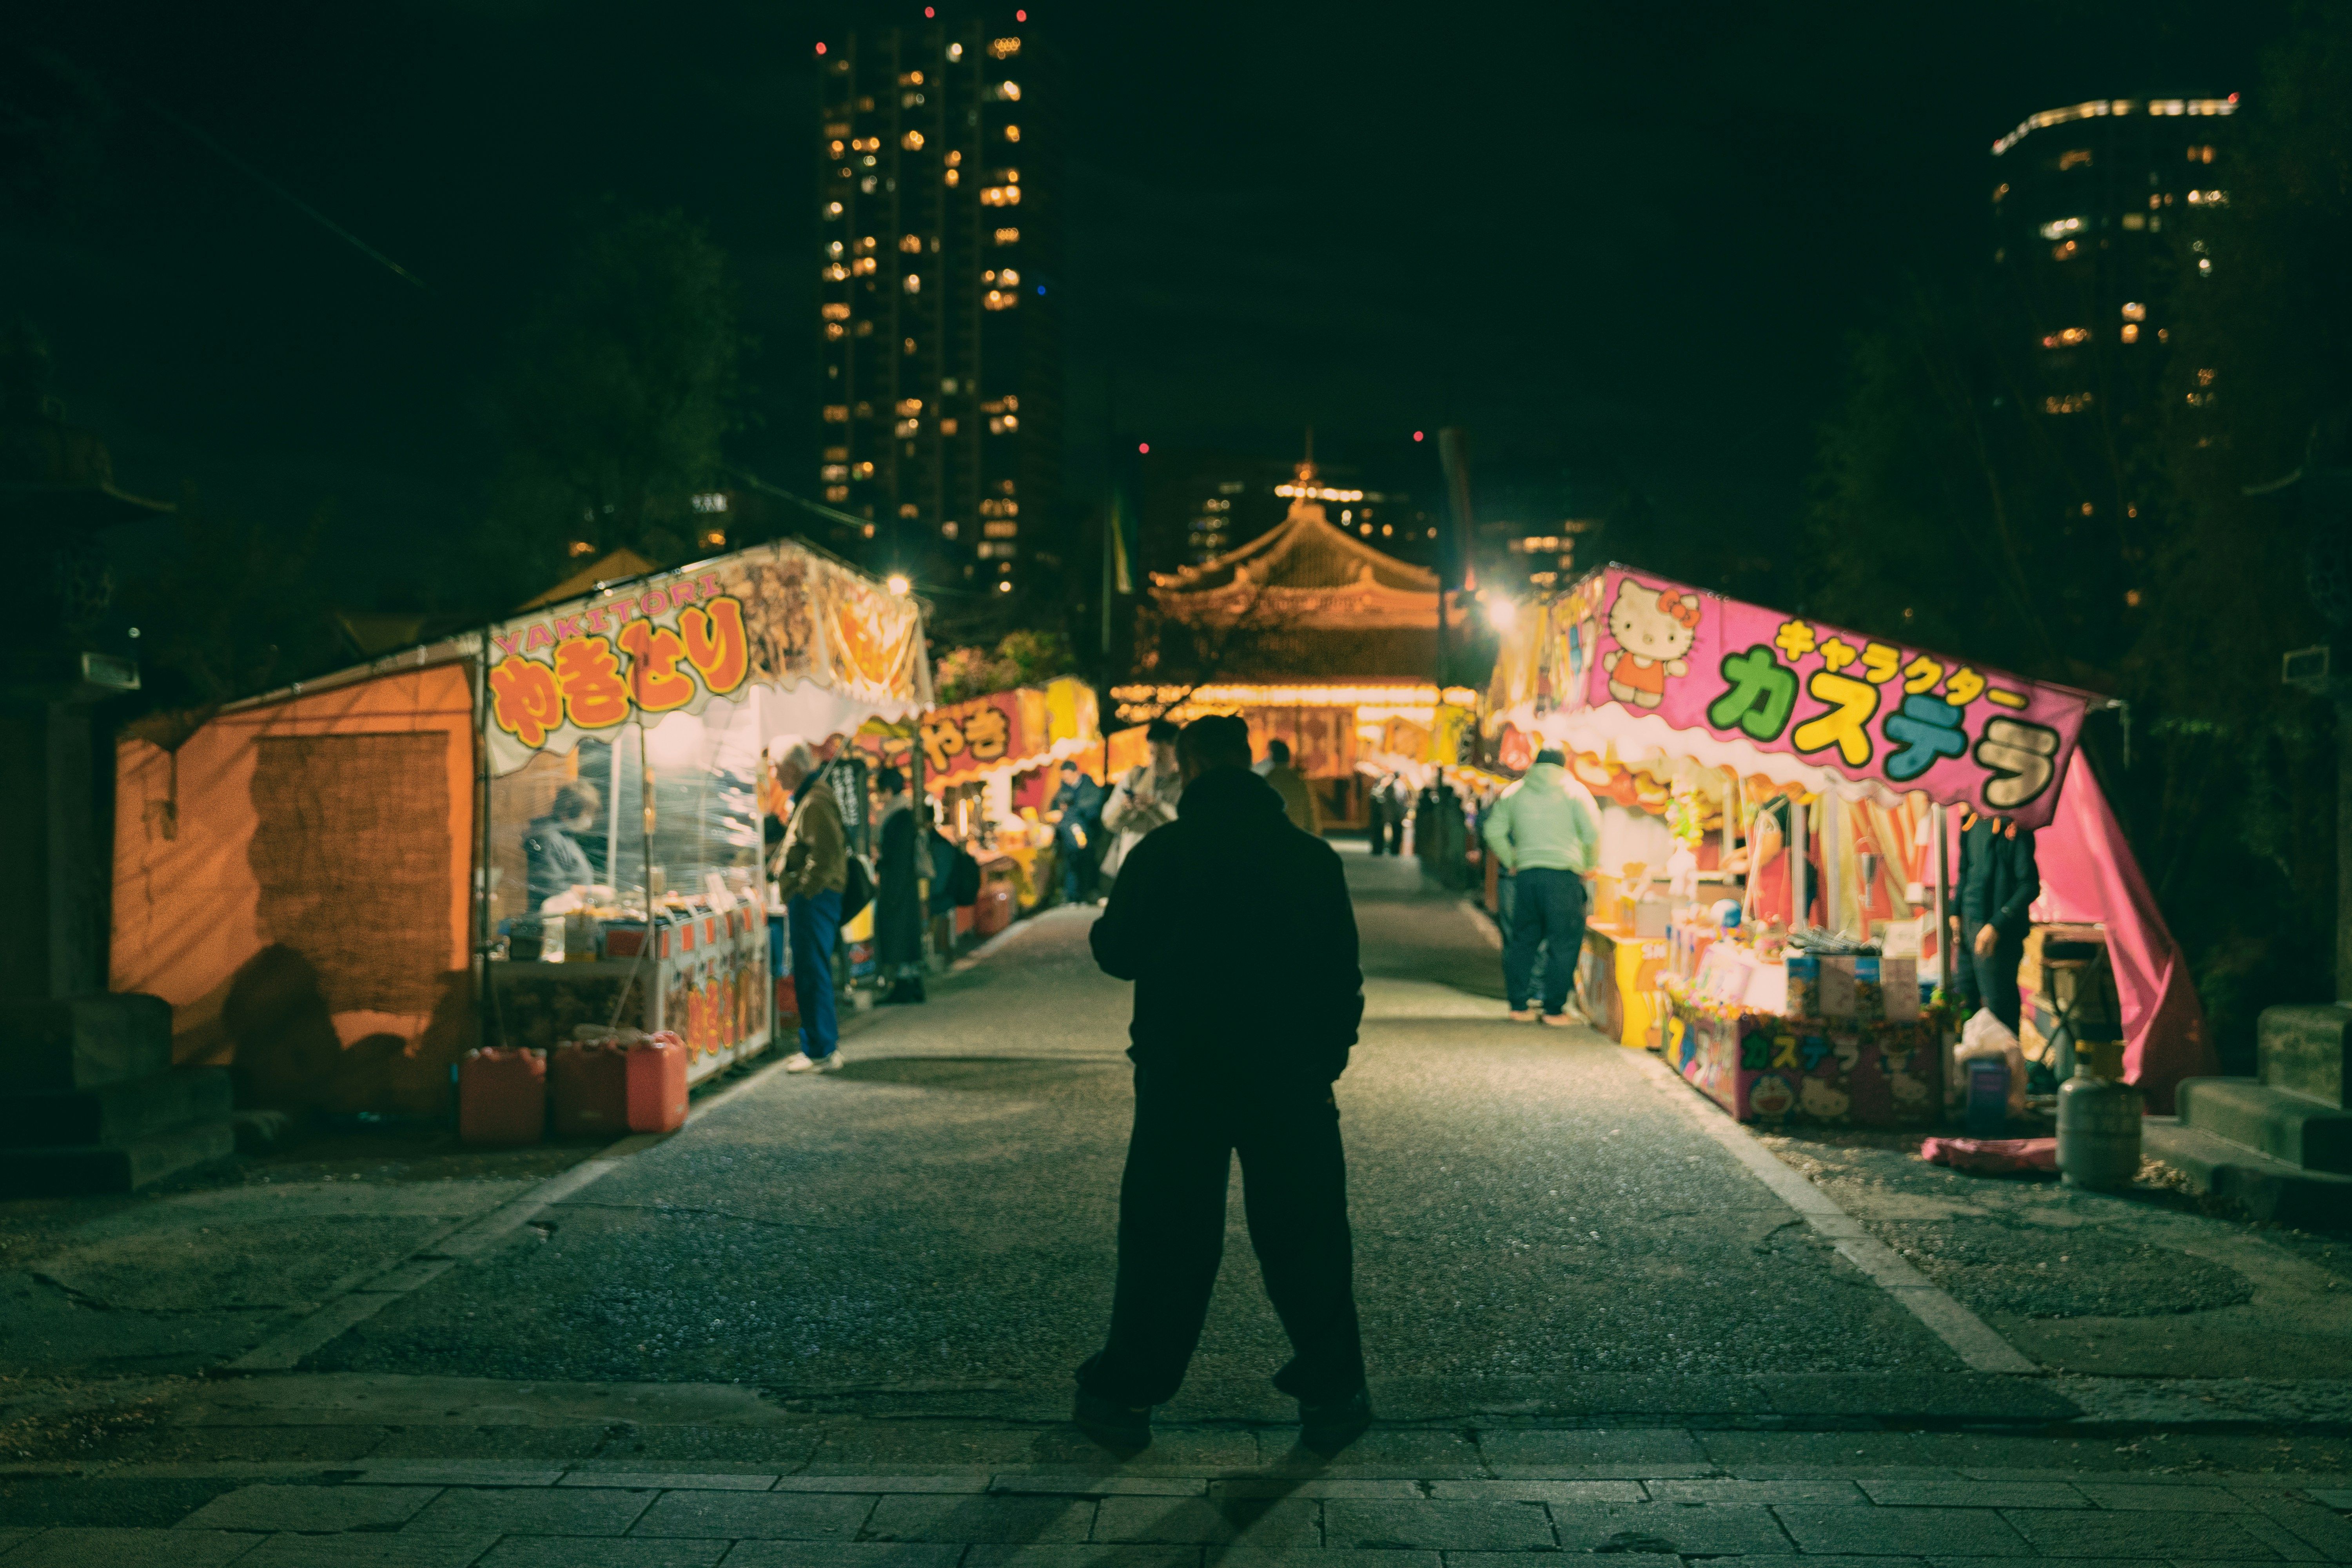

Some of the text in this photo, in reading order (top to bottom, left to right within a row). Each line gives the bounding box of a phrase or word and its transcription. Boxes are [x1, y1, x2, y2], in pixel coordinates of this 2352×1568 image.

[493, 572, 723, 656] YAKITORI
[488, 594, 749, 748] やきとり
[1774, 618, 2030, 710] キャラクター
[1706, 643, 2061, 810] カステラ
[1741, 1029, 1860, 1071] カステラ
